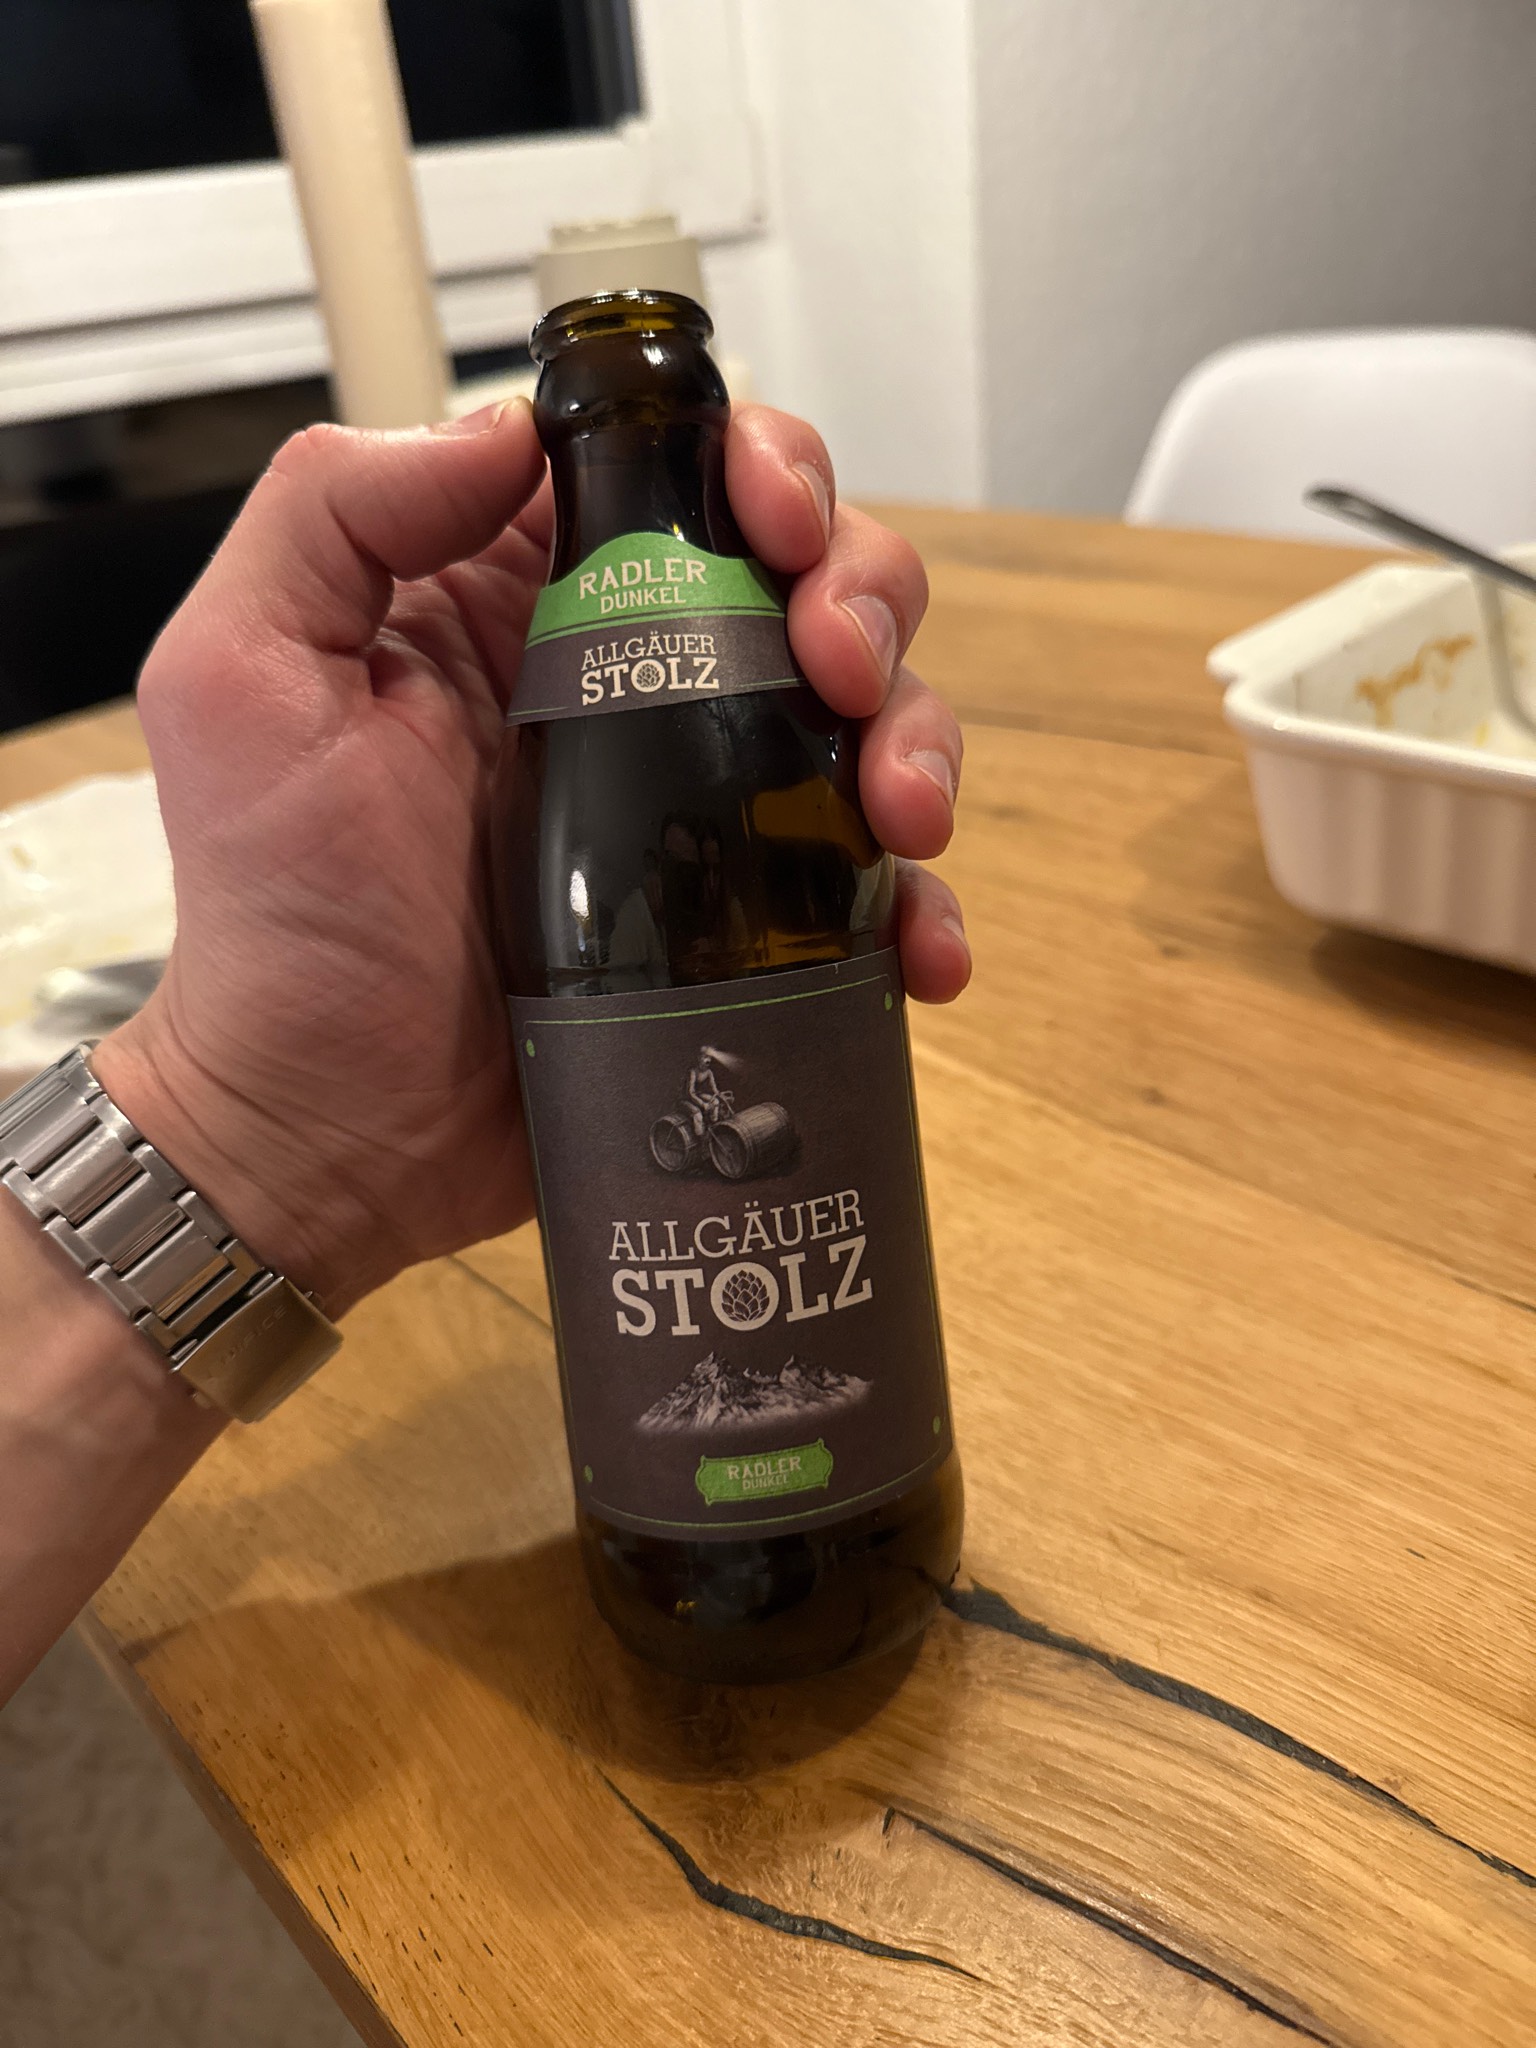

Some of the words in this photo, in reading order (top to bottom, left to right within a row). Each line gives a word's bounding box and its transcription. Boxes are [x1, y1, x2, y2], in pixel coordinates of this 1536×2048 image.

[579, 558, 707, 600] RADLER
[600, 587, 686, 614] DUNKEL
[581, 631, 716, 671] ALLGÄUER
[581, 657, 719, 705] STOLZ
[609, 1189, 864, 1261] ALLGÄUER
[612, 1234, 873, 1336] STOLZ
[728, 1456, 801, 1480] RADLER
[742, 1474, 789, 1490] DUNKEL
